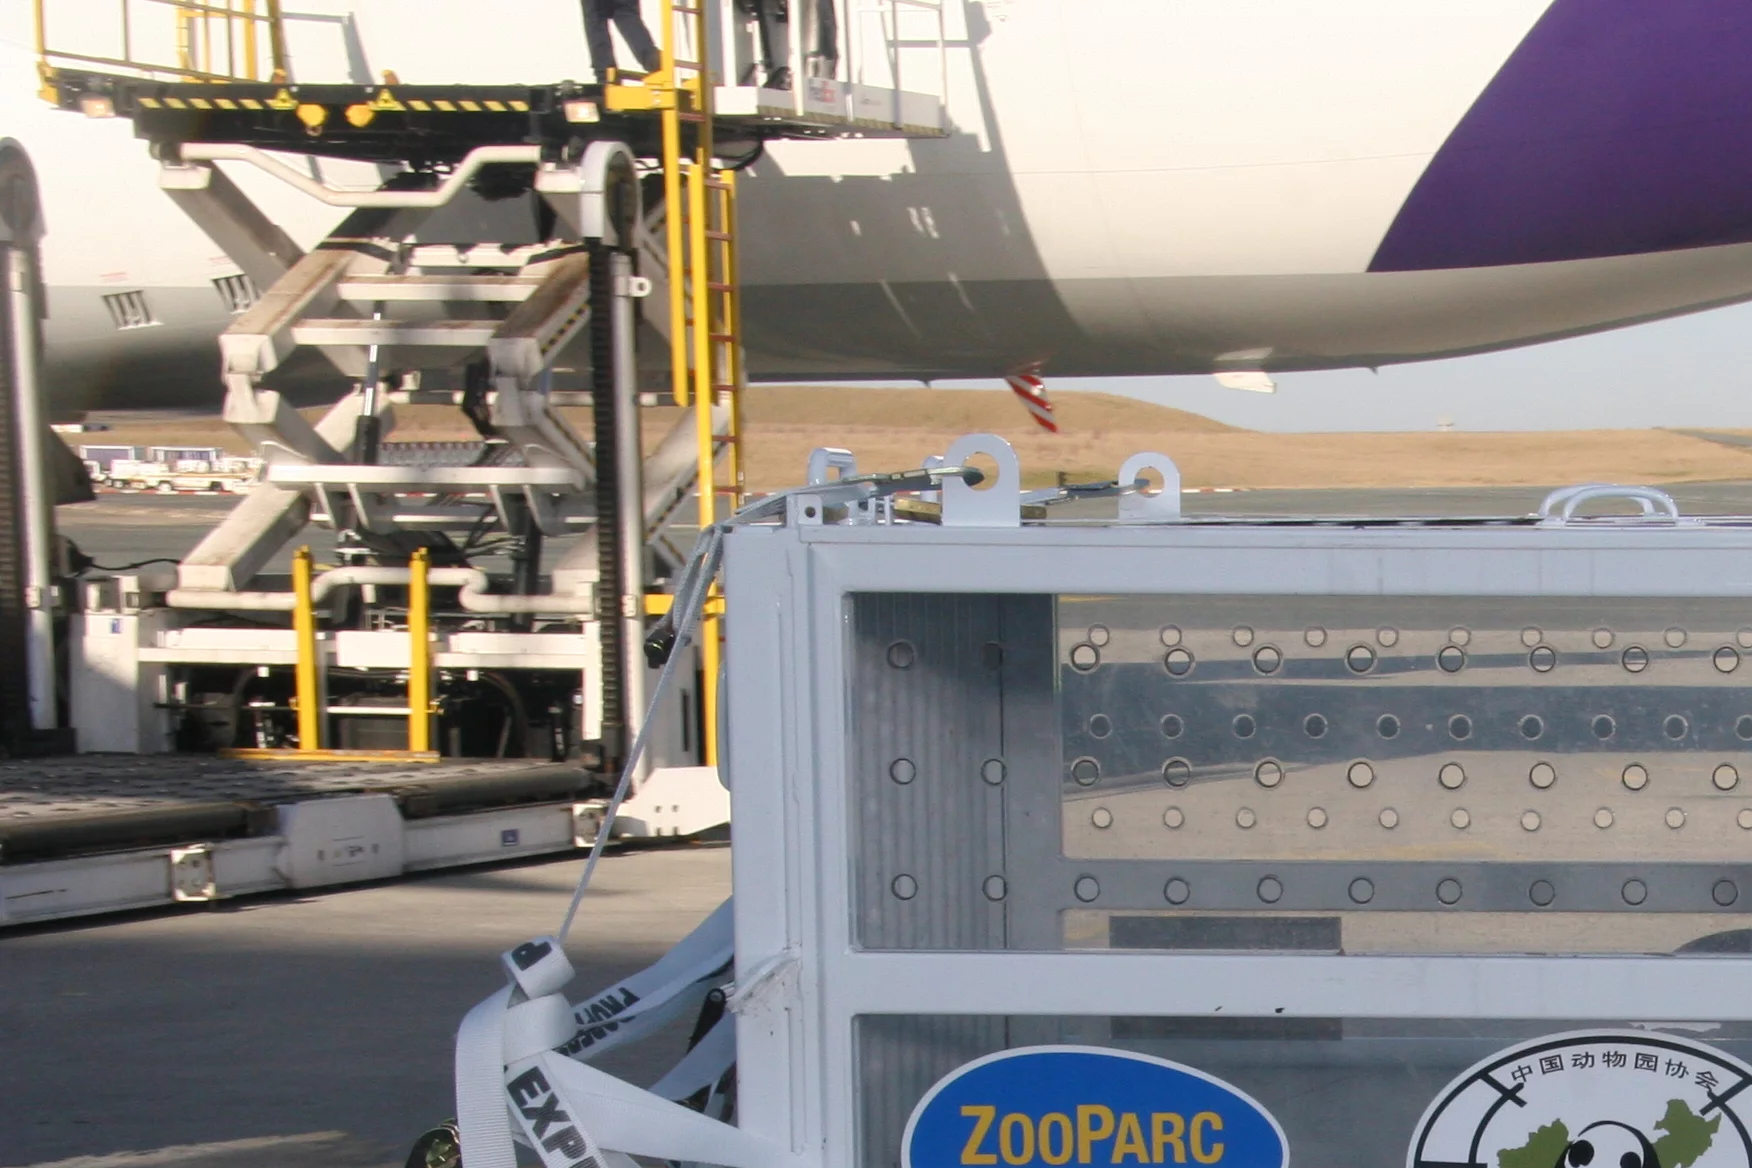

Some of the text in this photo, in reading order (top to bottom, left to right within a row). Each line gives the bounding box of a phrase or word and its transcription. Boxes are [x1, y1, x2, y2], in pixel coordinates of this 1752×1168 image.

[1510, 1050, 1720, 1091] 中国动物园协会
